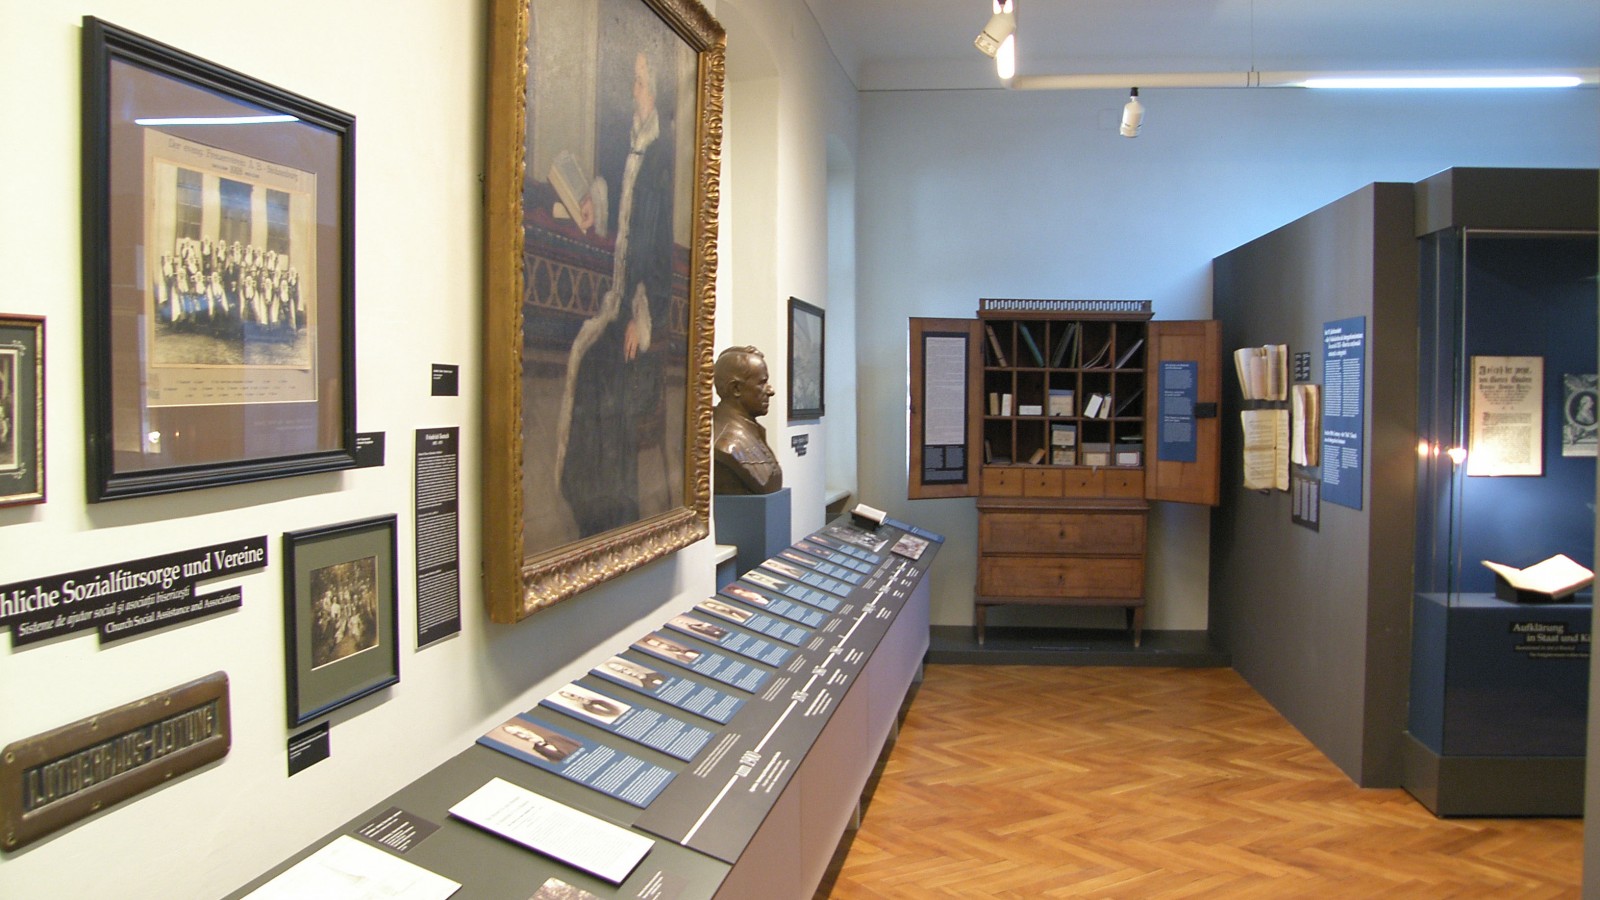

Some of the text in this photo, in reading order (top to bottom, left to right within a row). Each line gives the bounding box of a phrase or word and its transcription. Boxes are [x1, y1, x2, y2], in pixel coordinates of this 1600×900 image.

[0, 545, 264, 618] hliche Sozialfürsorge und Vereine
[104, 592, 241, 634] Church Social Assistance and Associations
[1513, 623, 1564, 634] Aufklärung
